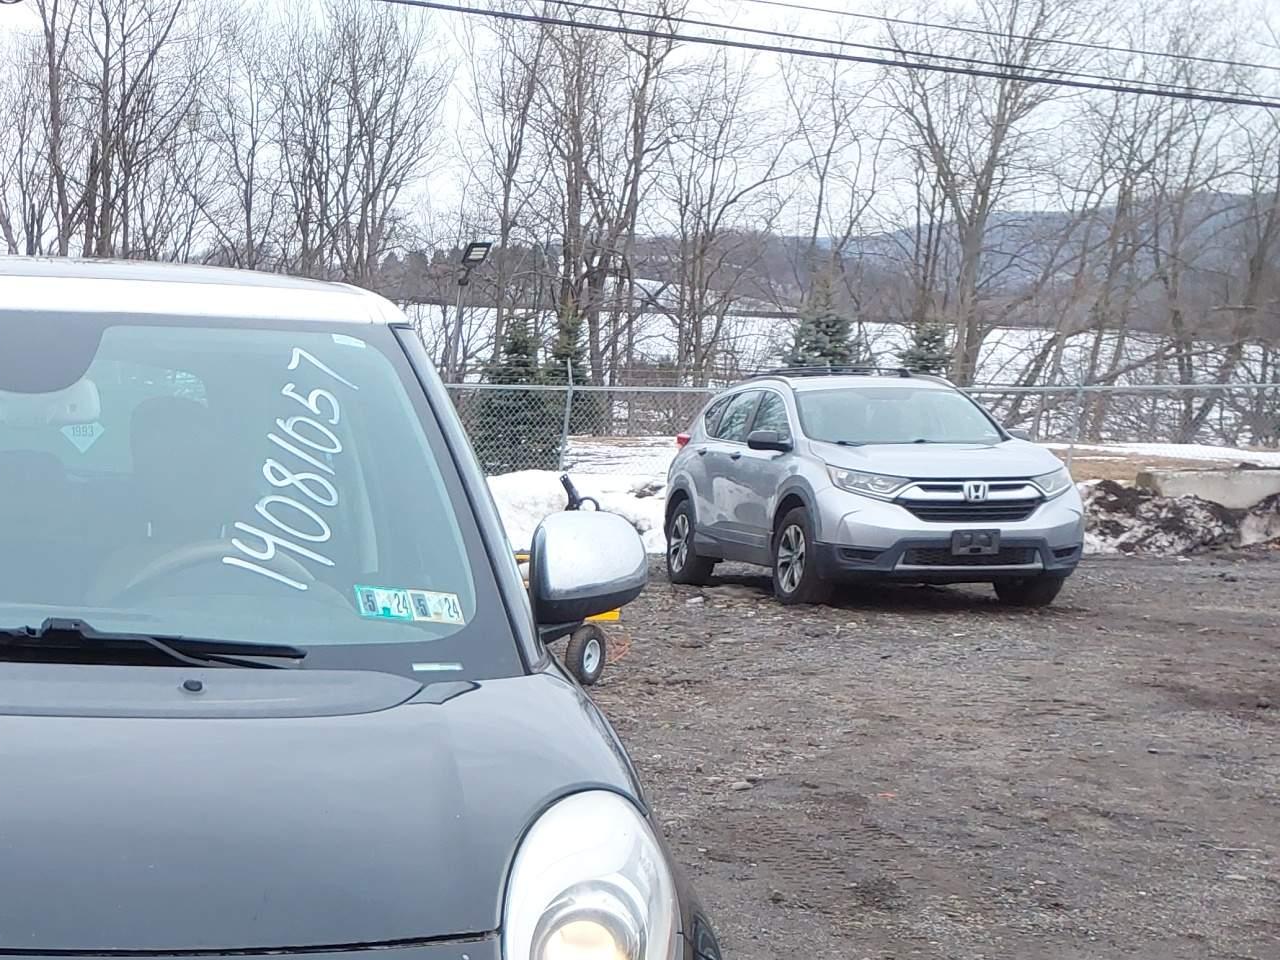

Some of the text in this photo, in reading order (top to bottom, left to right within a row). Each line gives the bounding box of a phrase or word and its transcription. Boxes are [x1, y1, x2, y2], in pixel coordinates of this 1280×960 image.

[222, 347, 360, 590] 14081057
[394, 592, 409, 614] 24
[444, 597, 460, 619] 24
